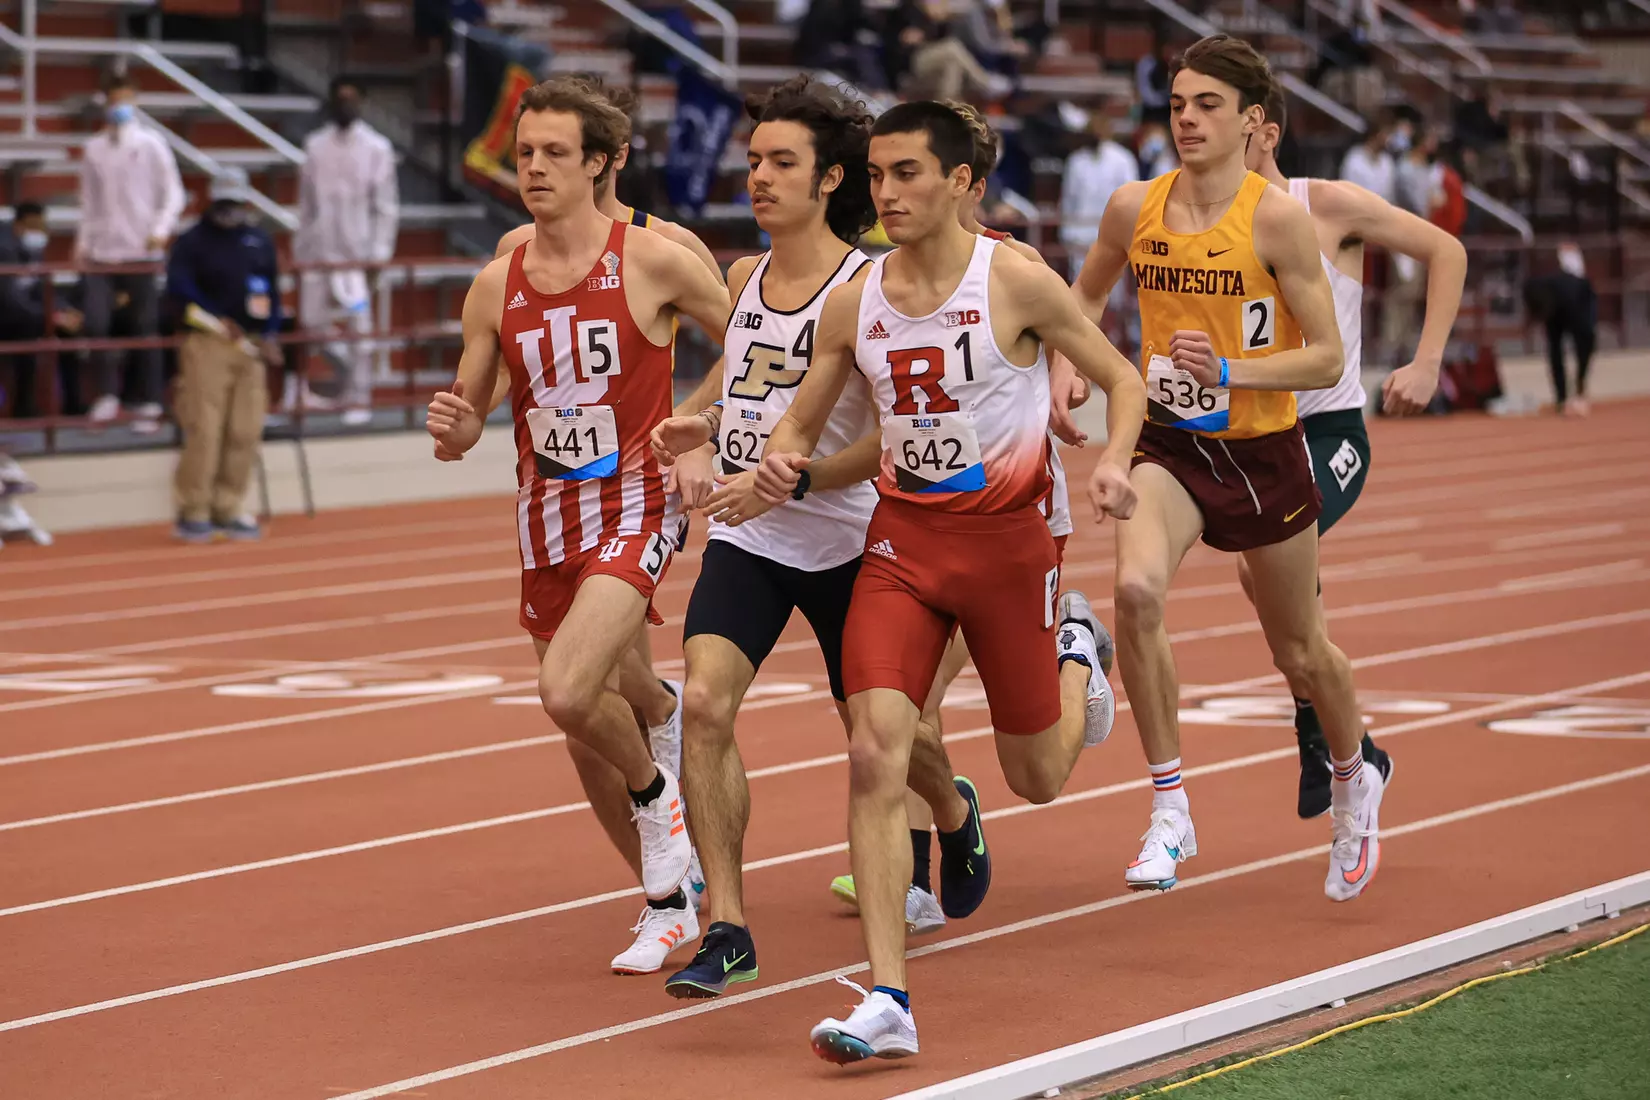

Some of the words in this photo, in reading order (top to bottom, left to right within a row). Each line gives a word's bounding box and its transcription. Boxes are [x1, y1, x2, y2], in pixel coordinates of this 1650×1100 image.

[1135, 263, 1245, 296] MINNESOTA
[507, 300, 528, 310] adidas
[865, 331, 891, 340] adidas
[1249, 301, 1269, 348] 2
[588, 326, 612, 375] 5
[792, 320, 816, 367] 4
[954, 331, 974, 381] 1
[728, 341, 809, 402] P
[886, 346, 960, 415] R
[1159, 377, 1216, 411] 536
[544, 427, 599, 458] 441
[726, 428, 770, 463] 62
[902, 438, 967, 471] 642
[1335, 447, 1357, 480] 3
[646, 534, 669, 575] 5
[868, 547, 898, 560] adidas
